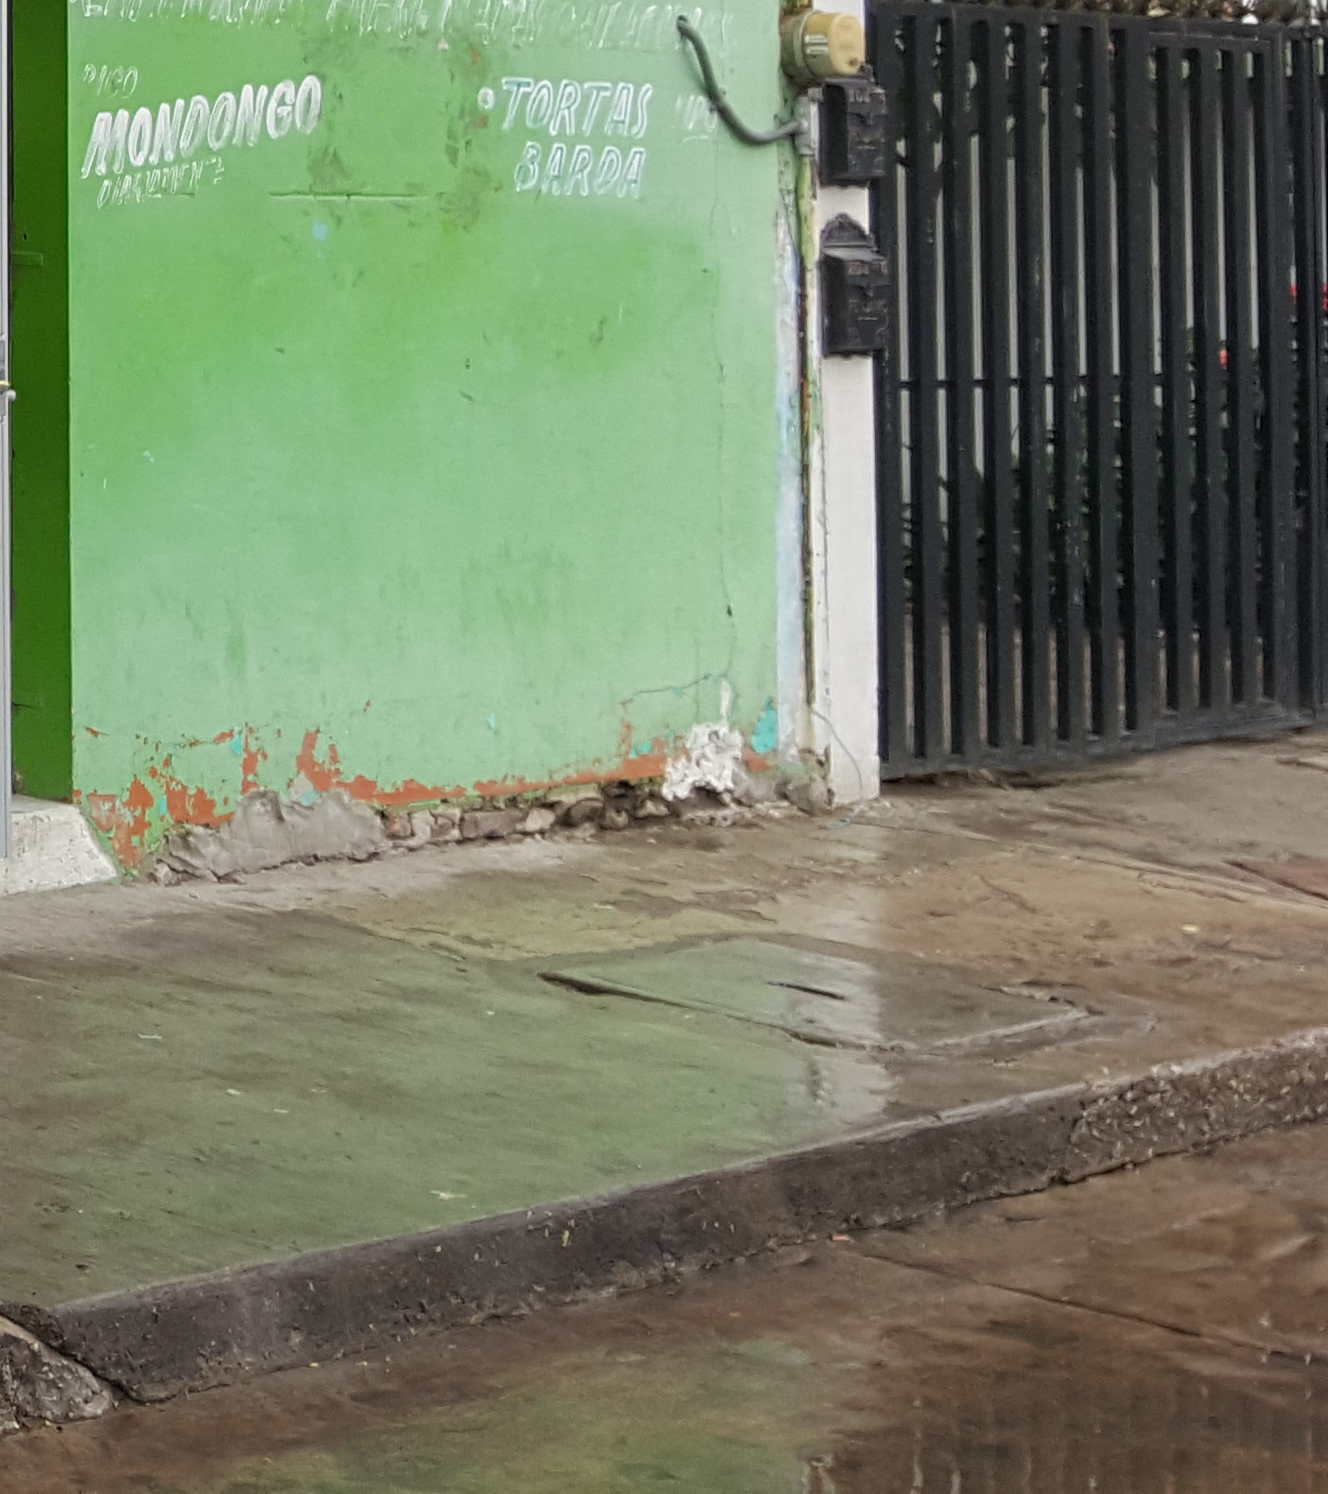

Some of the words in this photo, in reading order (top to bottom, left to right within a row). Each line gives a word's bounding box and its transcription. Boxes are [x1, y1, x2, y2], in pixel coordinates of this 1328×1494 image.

[80, 73, 324, 180] MONDONGO
[501, 77, 654, 139] TORTAS
[514, 140, 647, 200] BARDA
